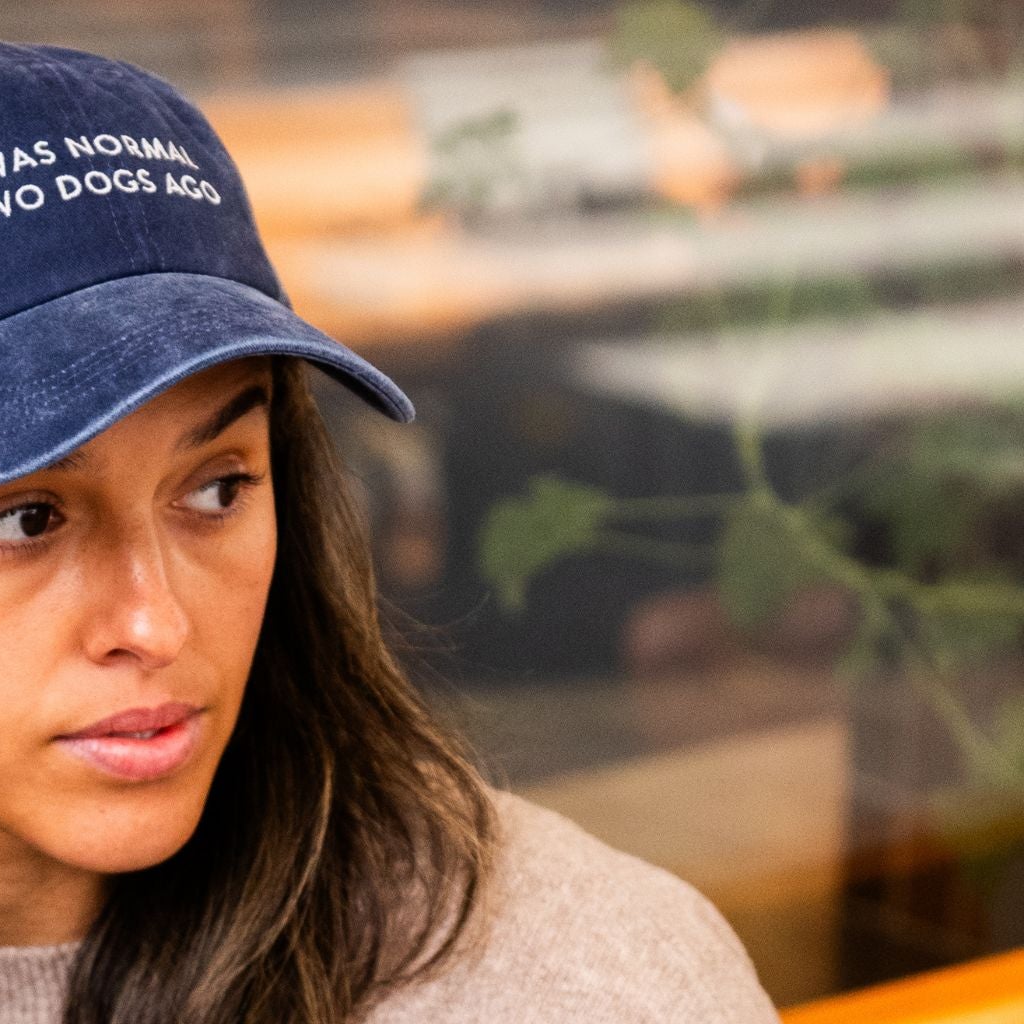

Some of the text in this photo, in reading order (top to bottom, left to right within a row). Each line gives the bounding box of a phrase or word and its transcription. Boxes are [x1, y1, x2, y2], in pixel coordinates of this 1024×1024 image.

[64, 134, 199, 170] NORMAL
[56, 169, 156, 200] DOGS
[166, 173, 221, 205] AGO
